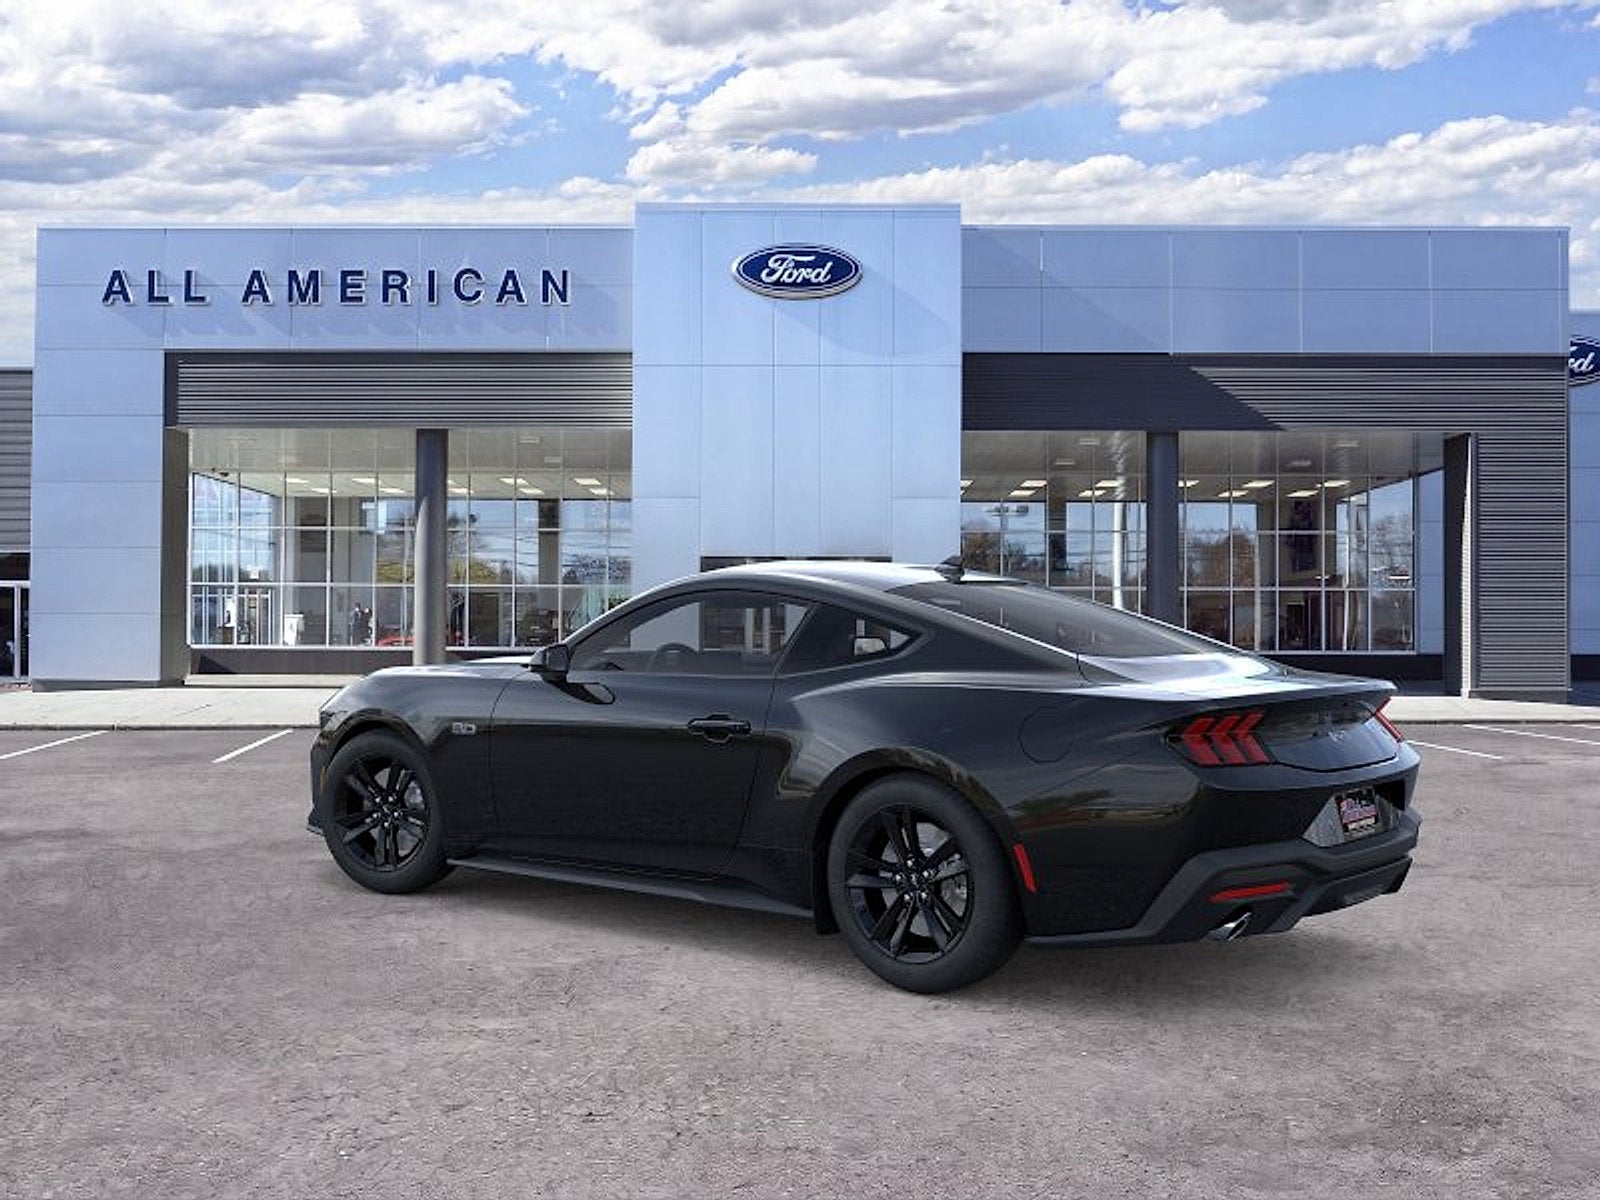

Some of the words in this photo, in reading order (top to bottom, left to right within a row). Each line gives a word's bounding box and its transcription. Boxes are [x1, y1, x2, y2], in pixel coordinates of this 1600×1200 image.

[760, 253, 833, 283] Ford
[102, 269, 209, 304] ALL
[242, 269, 572, 305] AMERICAN
